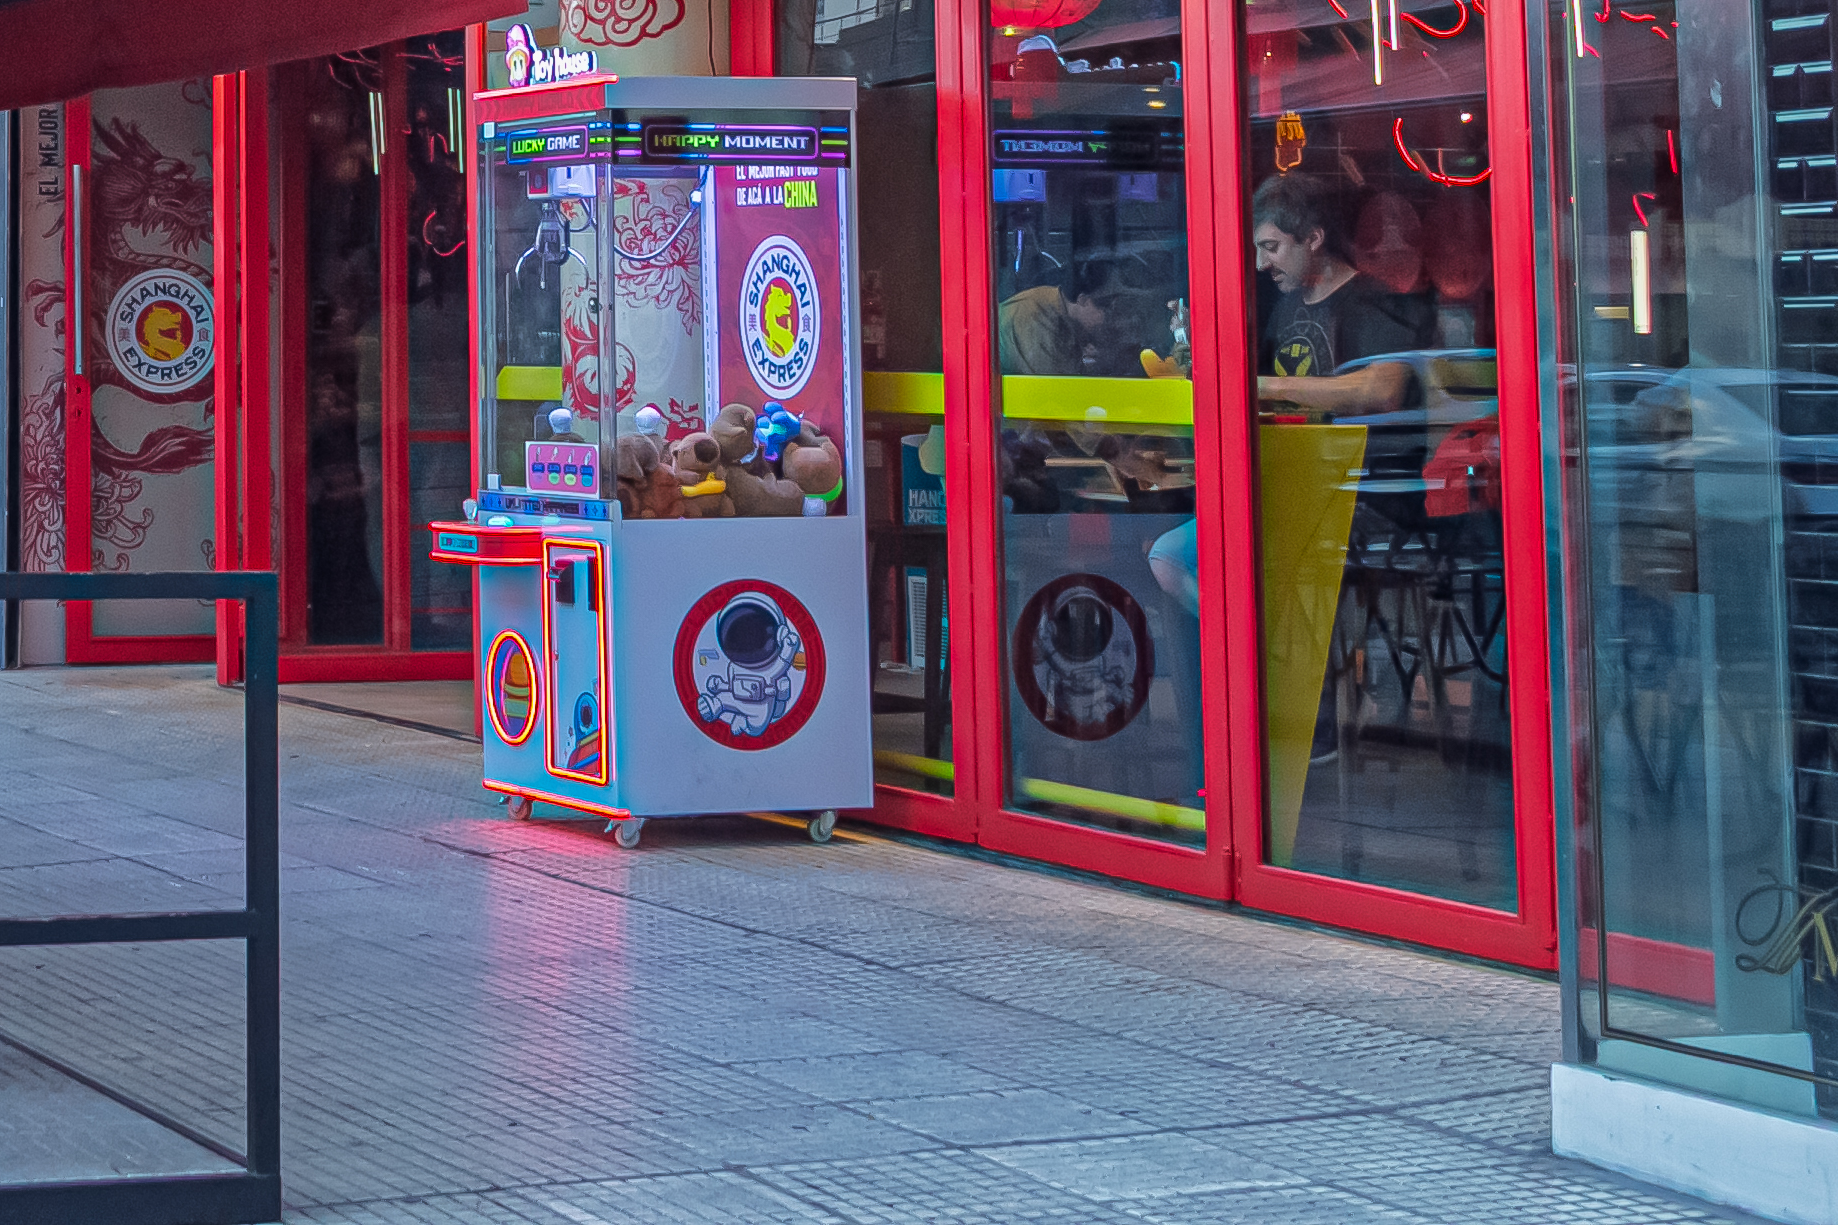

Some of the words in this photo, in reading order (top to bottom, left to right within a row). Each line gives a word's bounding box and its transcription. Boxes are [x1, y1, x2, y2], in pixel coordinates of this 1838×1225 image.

[38, 109, 58, 167] MEJOR
[512, 137, 546, 154] LUCKY
[547, 135, 581, 150] GAME
[654, 135, 720, 148] HAPPY
[724, 135, 809, 149] MOMENT
[38, 175, 58, 195] EL
[736, 187, 747, 206] DE
[747, 183, 763, 205] ACÁ
[764, 185, 772, 205] A
[772, 185, 784, 204] LA
[783, 180, 819, 208] CHINA
[749, 253, 811, 309] SHANGHAI
[120, 281, 210, 324] SHANGHAI
[122, 346, 206, 381] EXPRESS
[751, 337, 809, 383] EXPRESS
